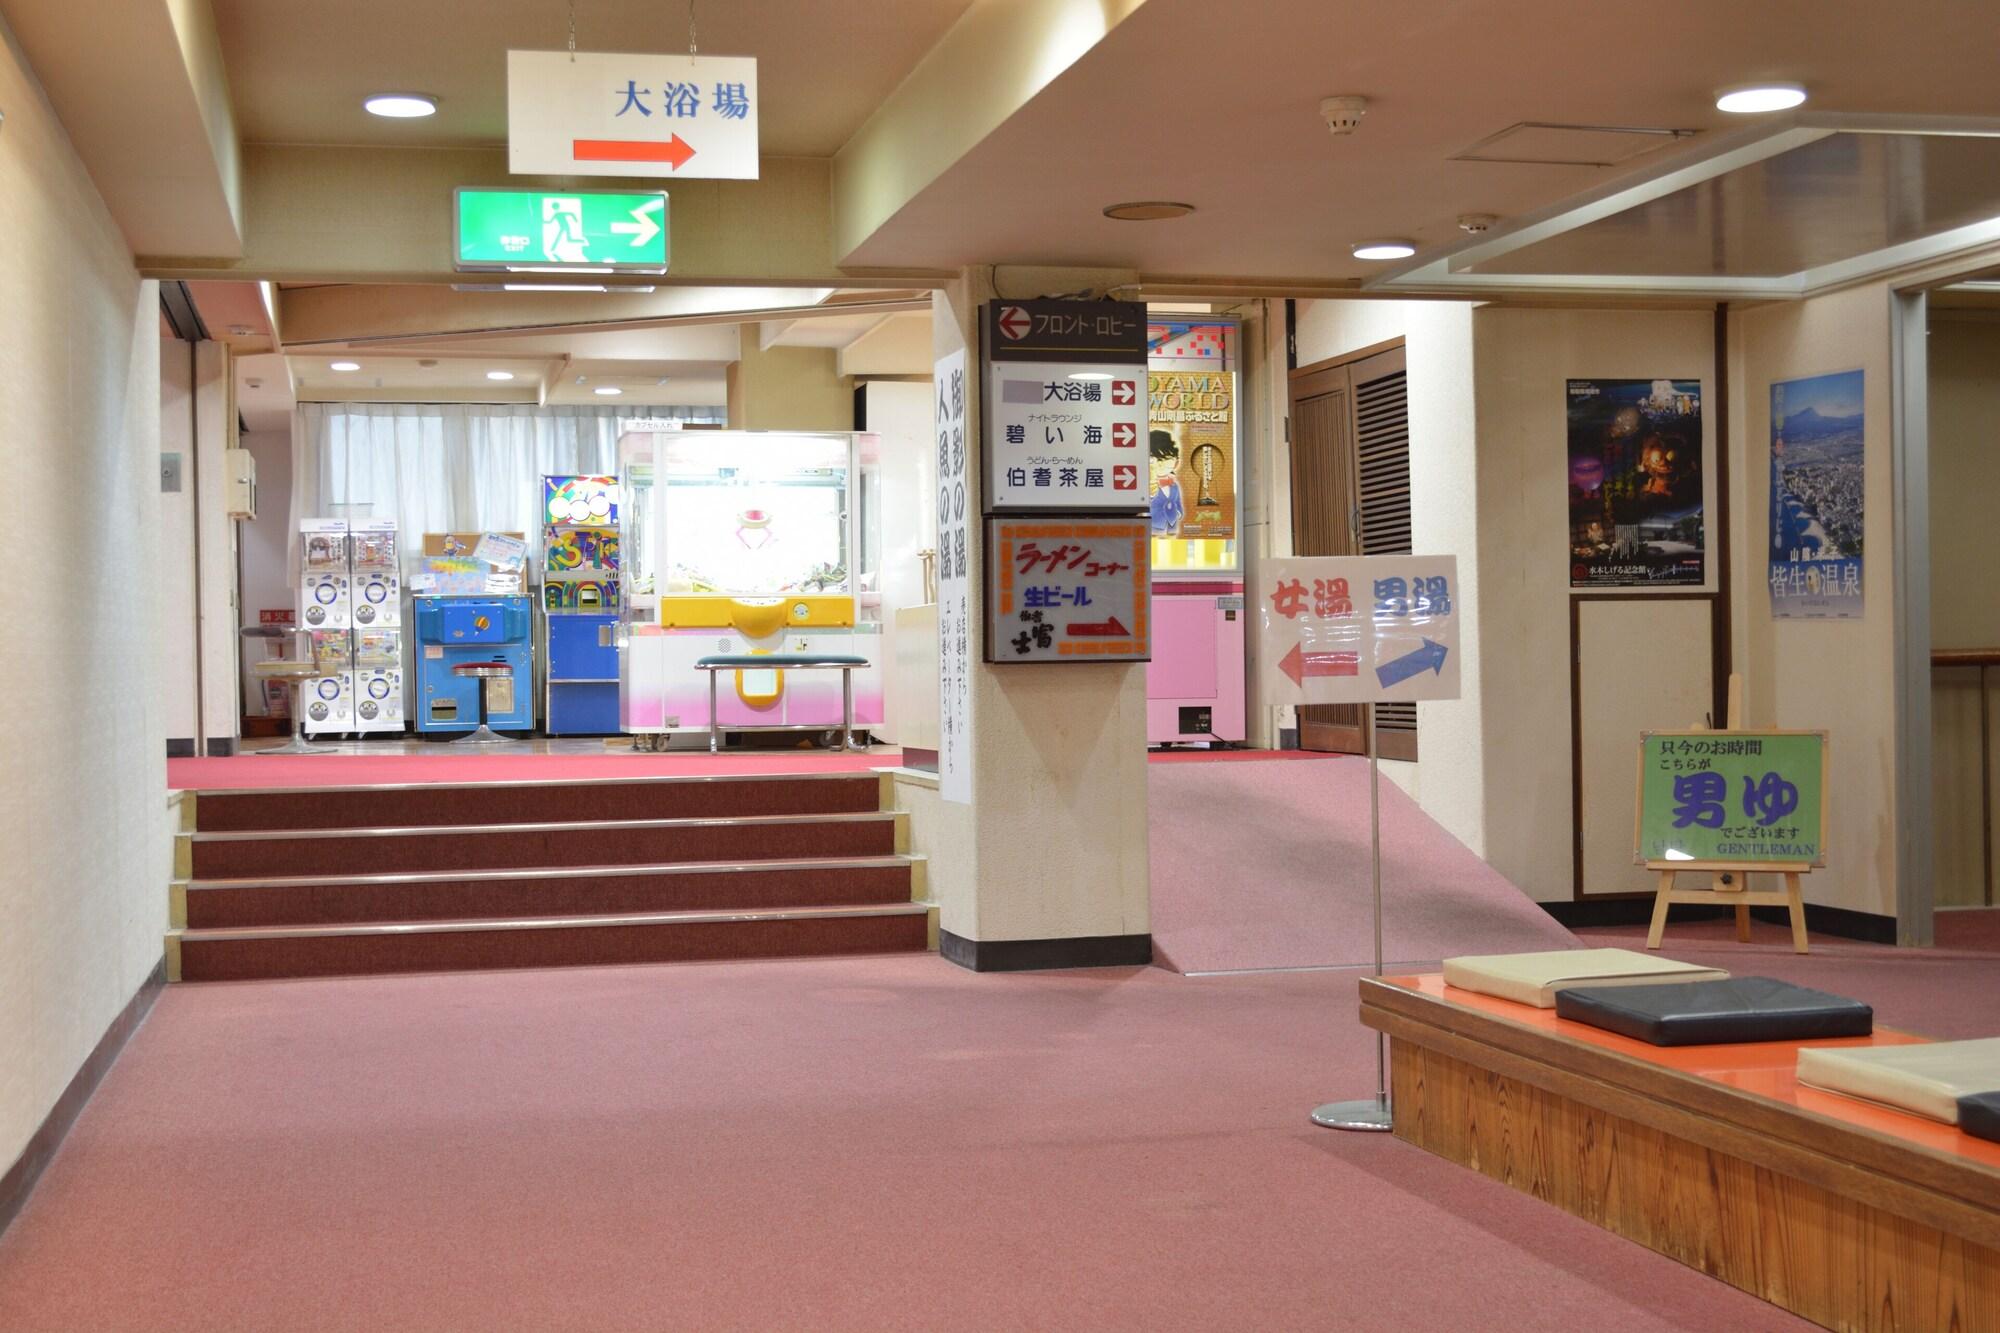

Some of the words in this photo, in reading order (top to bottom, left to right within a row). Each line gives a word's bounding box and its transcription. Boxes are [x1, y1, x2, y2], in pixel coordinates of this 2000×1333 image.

[614, 79, 751, 120] 大浴場
[1043, 381, 1102, 403] 大浴場
[1005, 424, 1103, 445] 碧い海
[1006, 466, 1105, 488] 伯耆茶屋
[1769, 562, 1861, 598] 皆生温泉
[1023, 585, 1093, 608] 生ビール
[1270, 577, 1353, 620] 女湯
[1373, 575, 1452, 618] 男湯
[1659, 740, 1763, 757] 只今のお時間
[1659, 757, 1712, 771] こちらが
[1671, 771, 1799, 830] 男ゆ
[1719, 825, 1800, 840] でございます
[1715, 842, 1816, 856] GENTLEMAN
